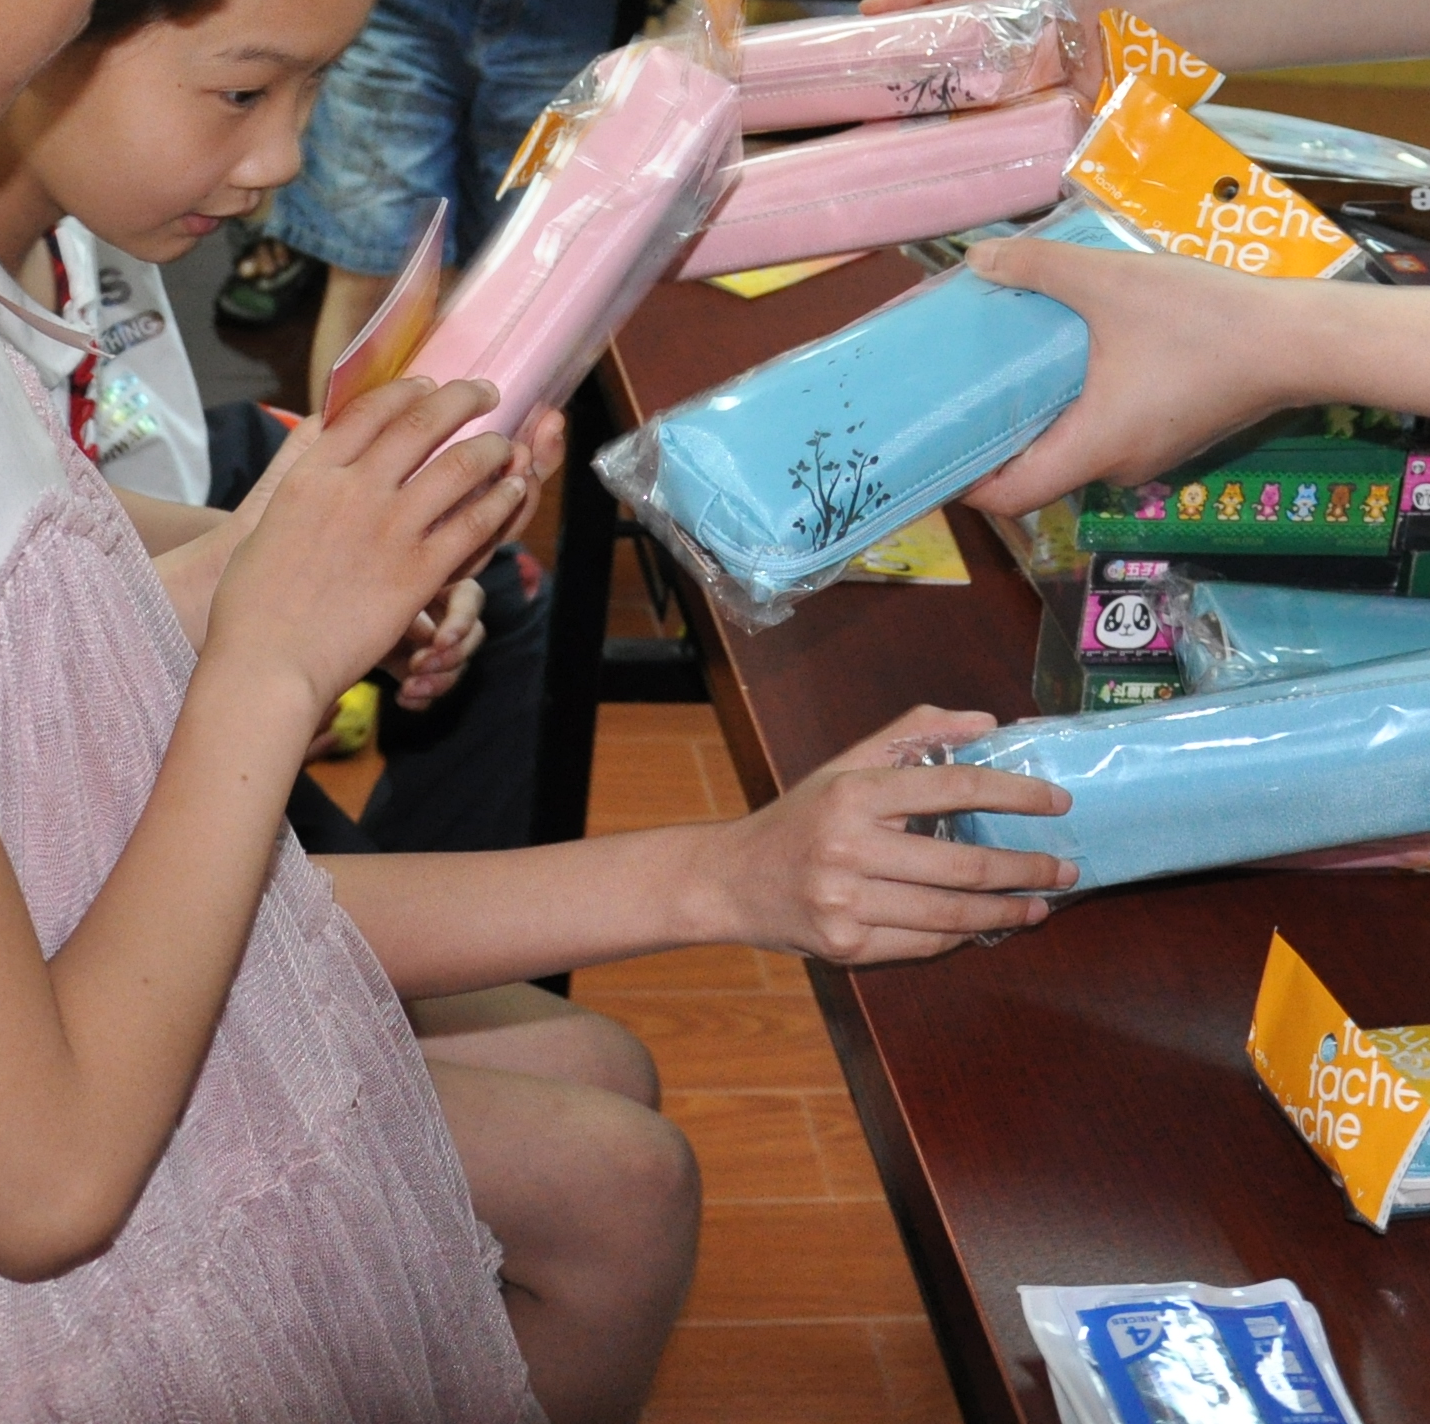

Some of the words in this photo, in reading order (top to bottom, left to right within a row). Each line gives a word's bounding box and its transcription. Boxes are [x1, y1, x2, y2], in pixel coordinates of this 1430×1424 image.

[1196, 192, 1345, 244] tache
[1307, 1052, 1422, 1114] tache
[1111, 1314, 1159, 1326] PIECES
[1126, 1325, 1153, 1347] 4
